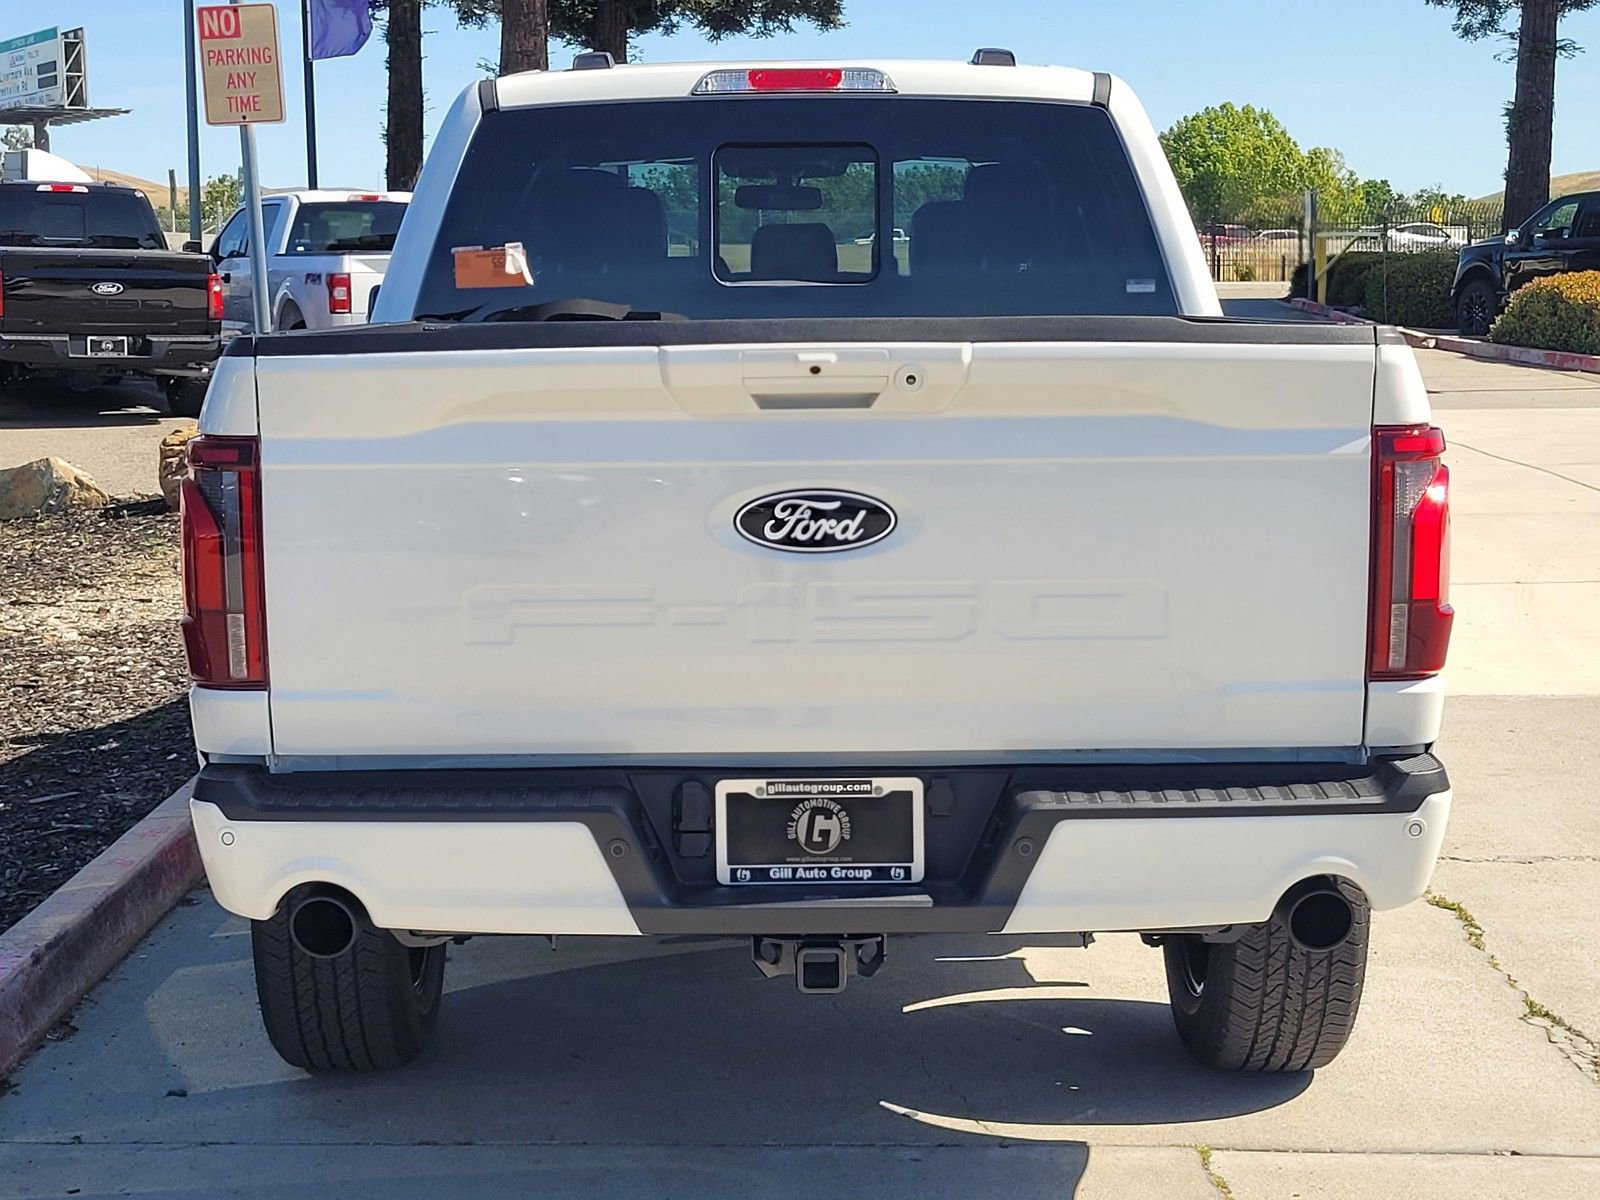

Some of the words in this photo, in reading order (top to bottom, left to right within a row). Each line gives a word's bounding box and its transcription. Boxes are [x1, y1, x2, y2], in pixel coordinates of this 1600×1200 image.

[202, 9, 236, 37] NO
[207, 47, 272, 66] PARKING
[226, 72, 257, 89] ANY
[226, 95, 262, 113] TIME
[763, 499, 867, 541] Ford
[463, 579, 1170, 646] F-150
[767, 782, 872, 795] gillautogroup.com
[790, 798, 842, 821] AUTOMOTIVE
[786, 820, 797, 840] GILL
[837, 810, 851, 840] GROUP
[769, 868, 792, 879] Gill
[795, 868, 828, 879] Auto
[830, 867, 873, 880] Group
